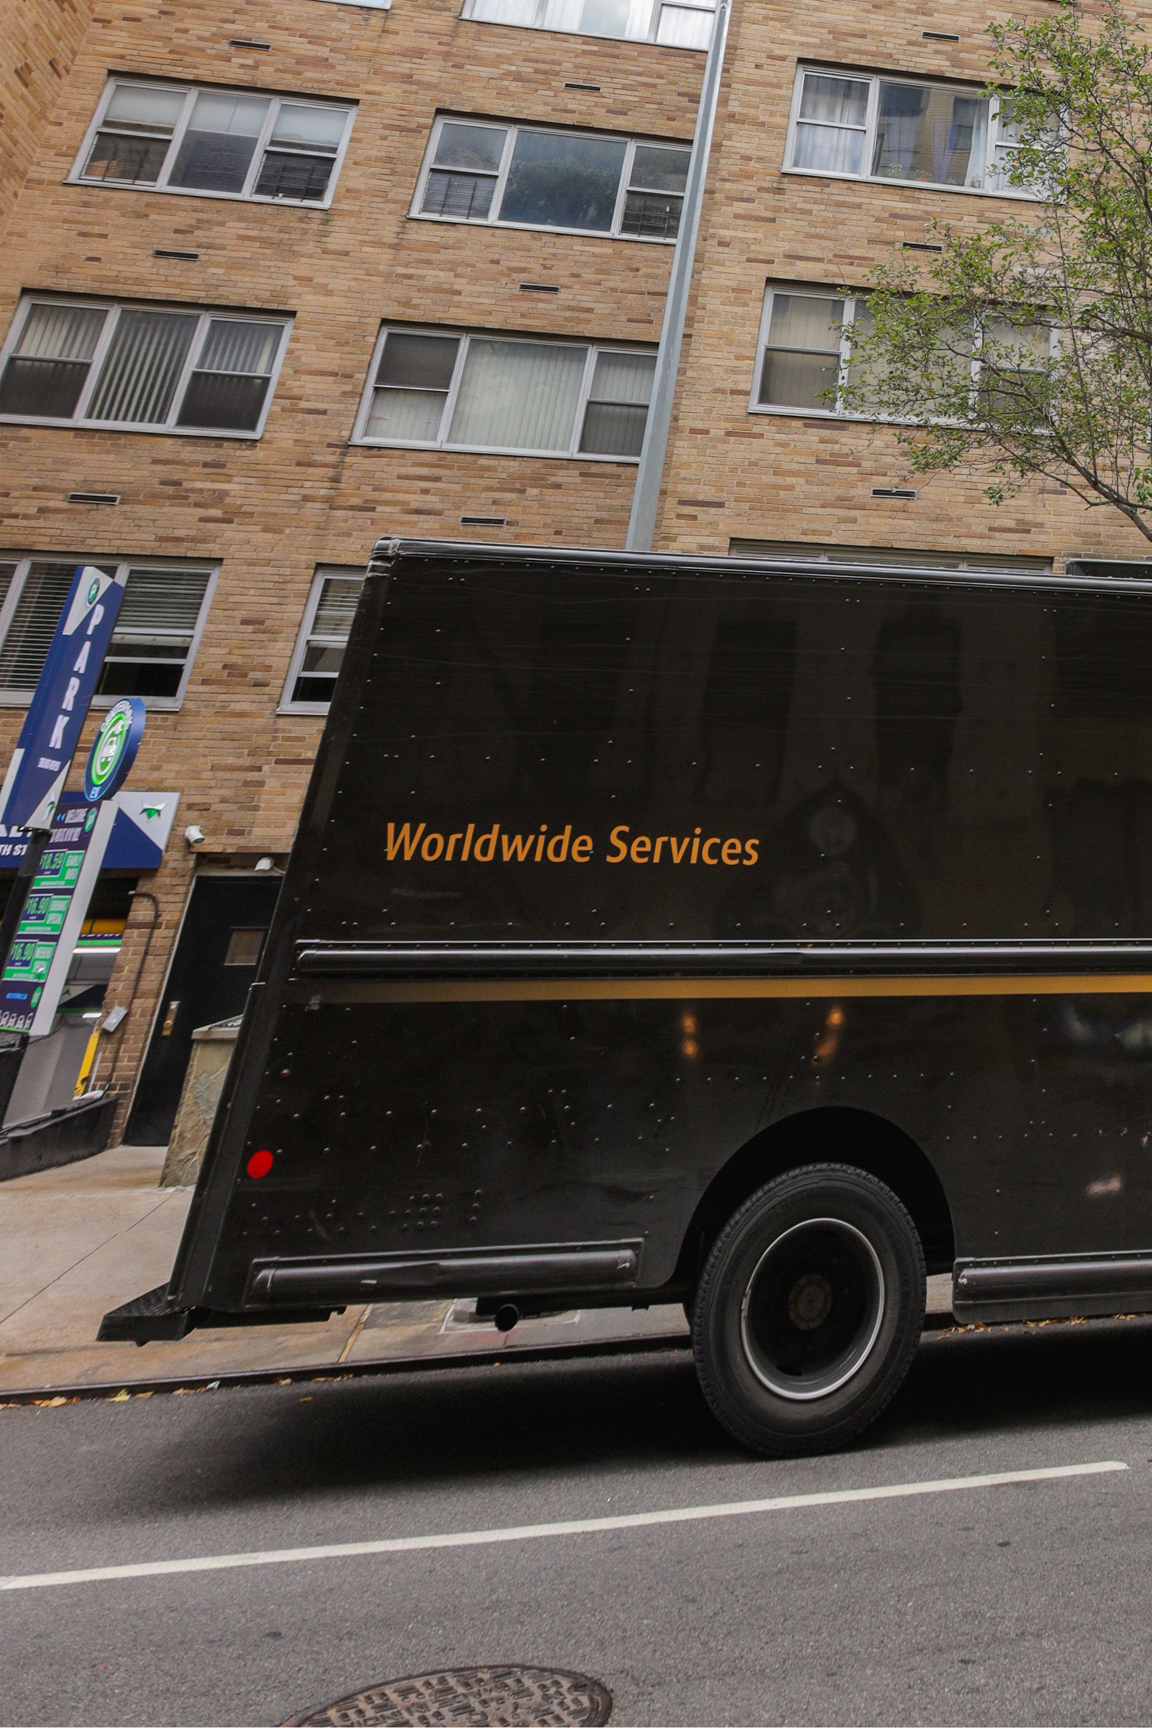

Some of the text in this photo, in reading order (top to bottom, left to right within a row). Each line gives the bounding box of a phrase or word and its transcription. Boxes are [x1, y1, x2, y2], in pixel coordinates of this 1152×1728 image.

[49, 603, 105, 750] PARK
[386, 822, 760, 866] Worldwide Services
[25, 896, 51, 915] $16.90
[10, 942, 36, 961] $16.90
